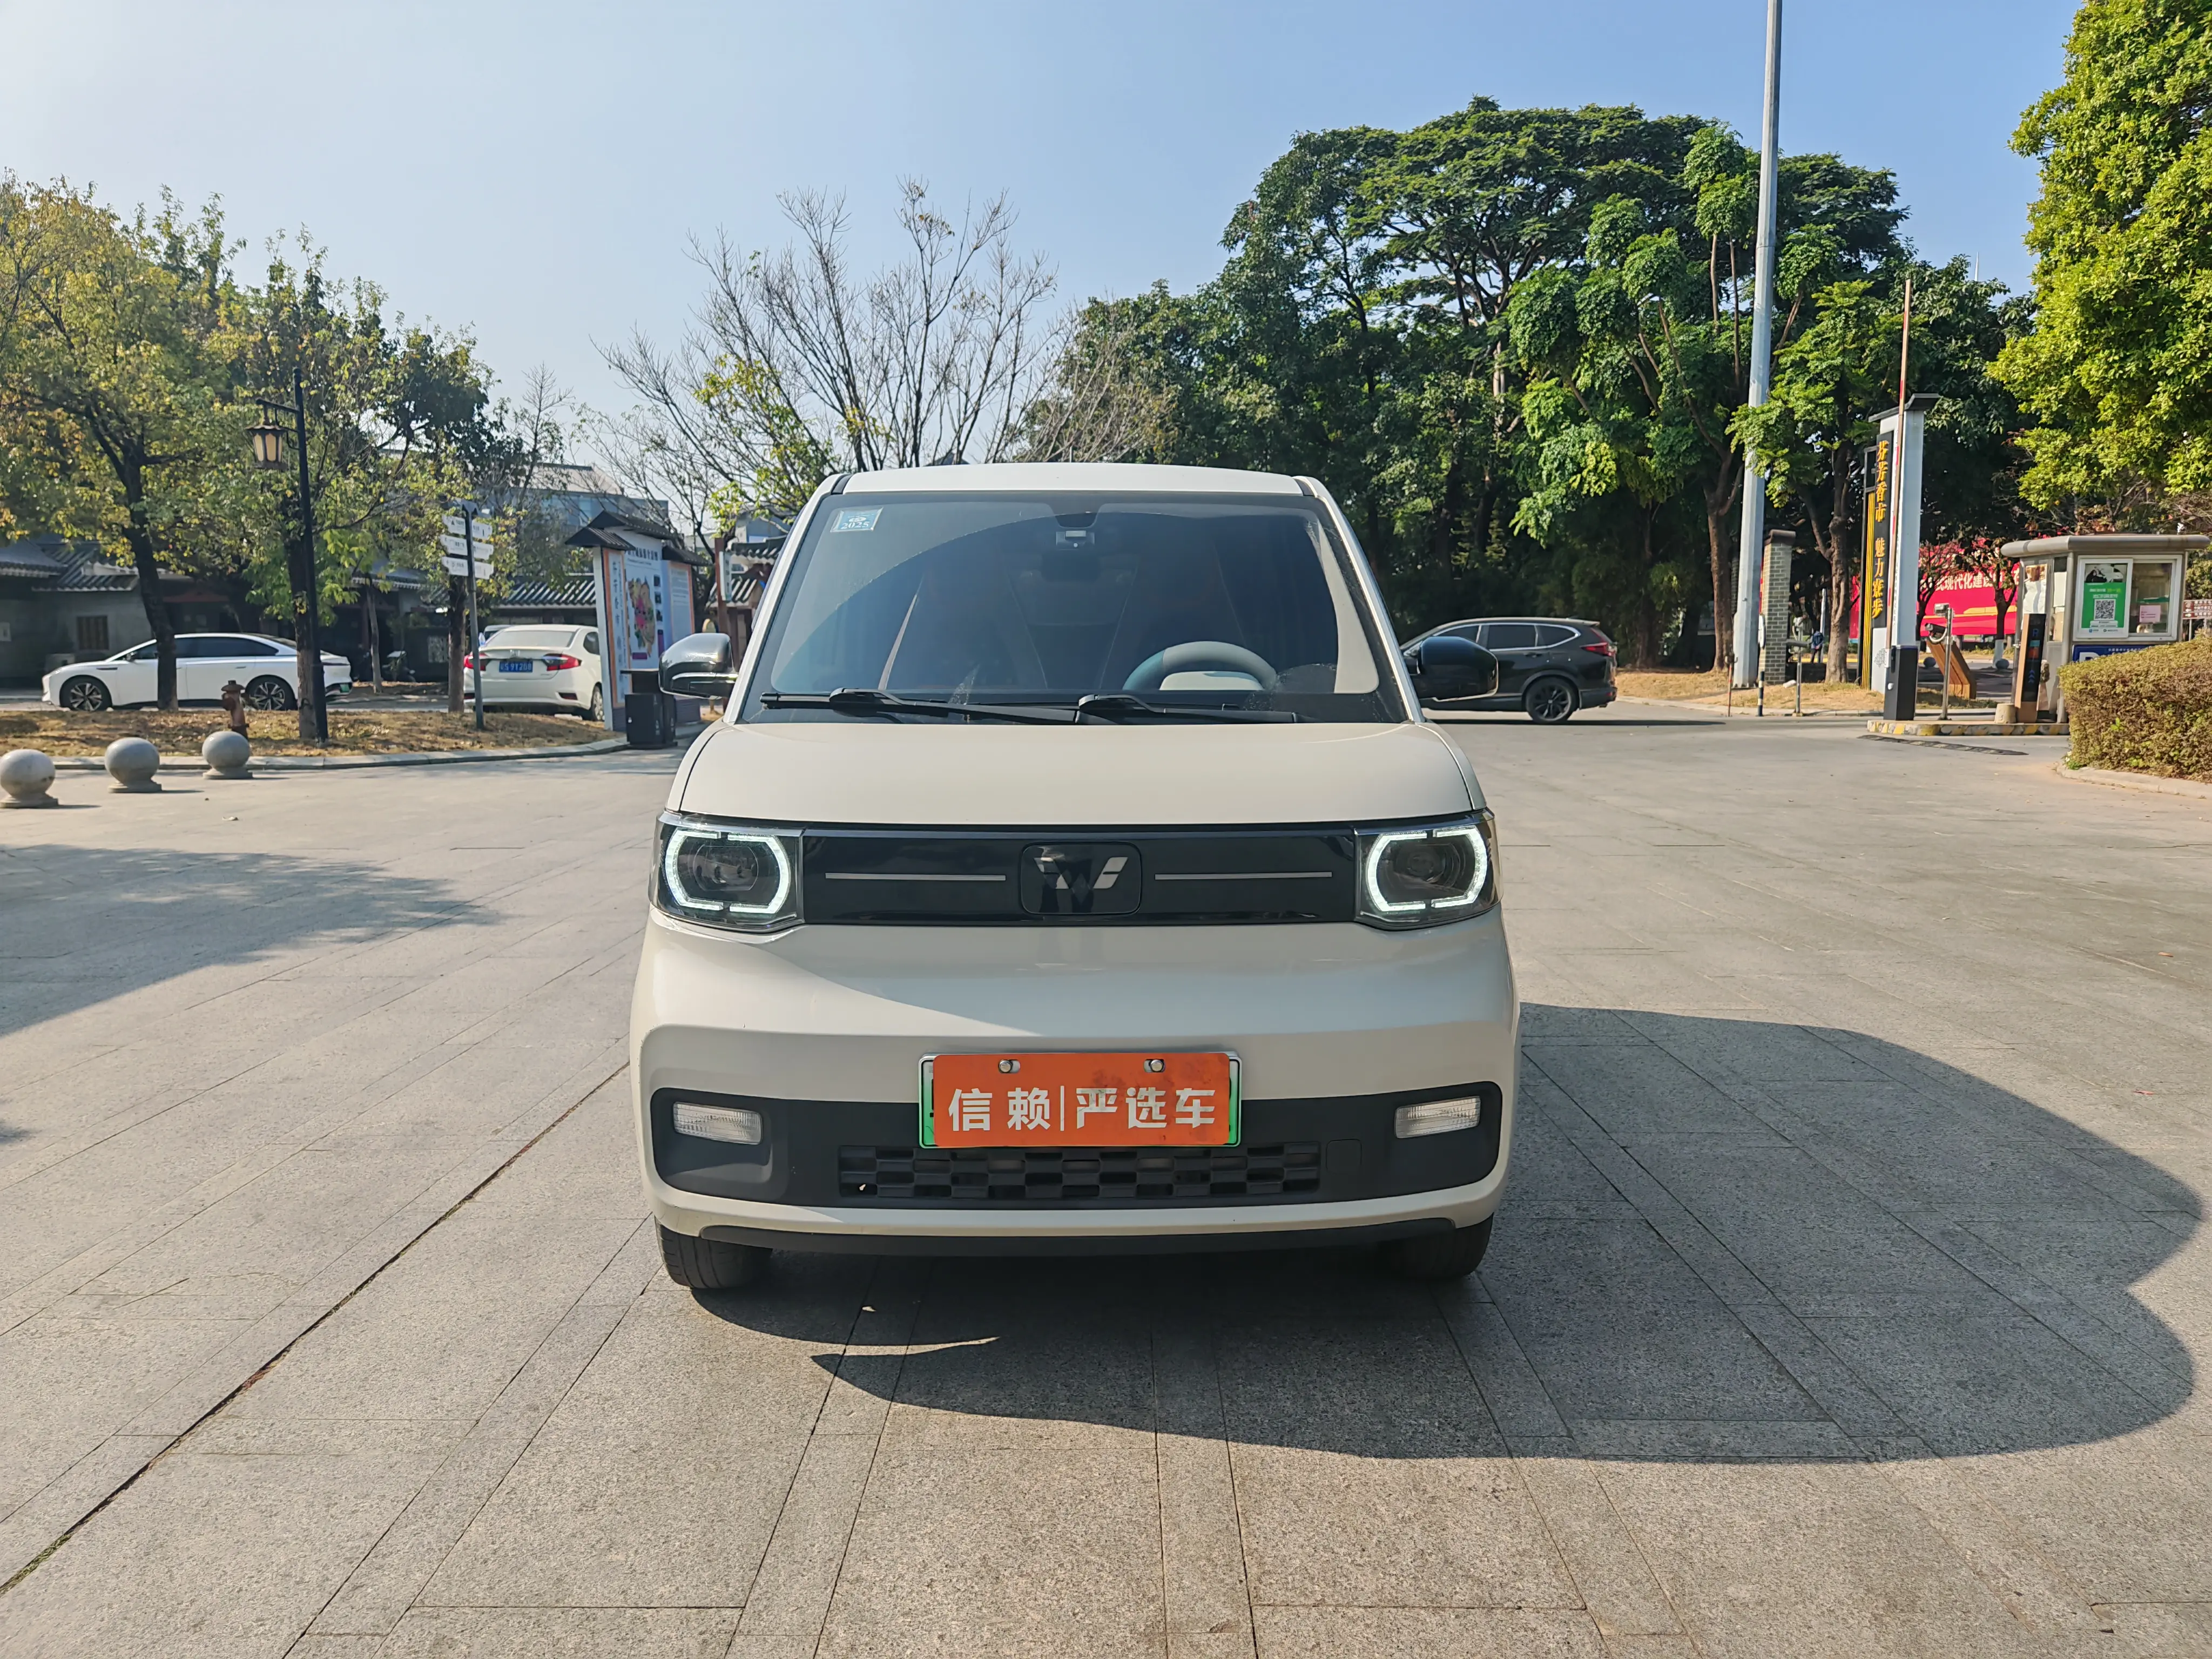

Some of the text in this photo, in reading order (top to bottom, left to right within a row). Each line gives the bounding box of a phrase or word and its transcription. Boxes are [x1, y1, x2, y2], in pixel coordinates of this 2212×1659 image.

[1872, 440, 1890, 619] 芬芳香市 魅力寮步
